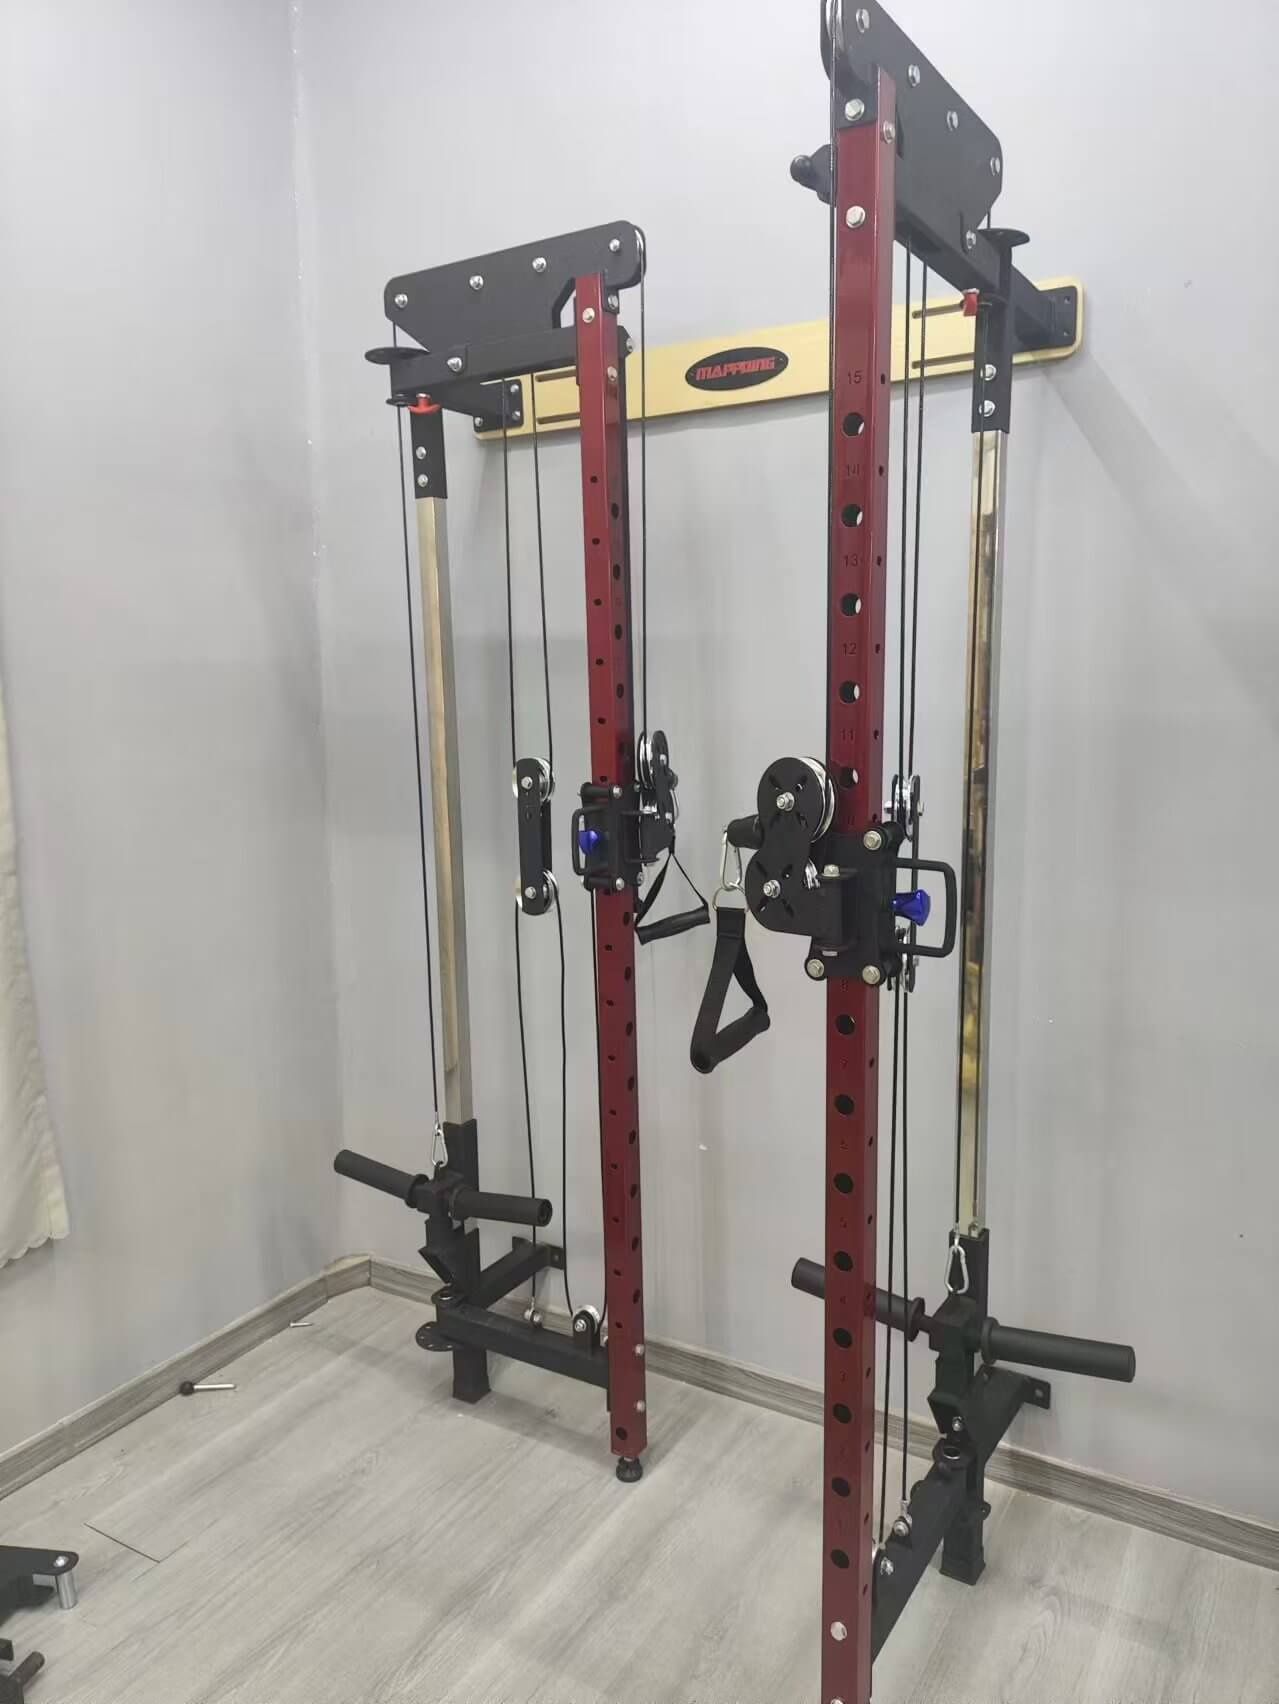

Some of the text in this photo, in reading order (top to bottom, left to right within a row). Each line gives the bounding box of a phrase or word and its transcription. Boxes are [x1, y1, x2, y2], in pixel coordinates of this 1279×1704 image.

[847, 370, 862, 385] 15
[846, 464, 860, 478] 14
[843, 553, 859, 569] 13
[842, 642, 857, 656] 12
[841, 728, 855, 742] 11
